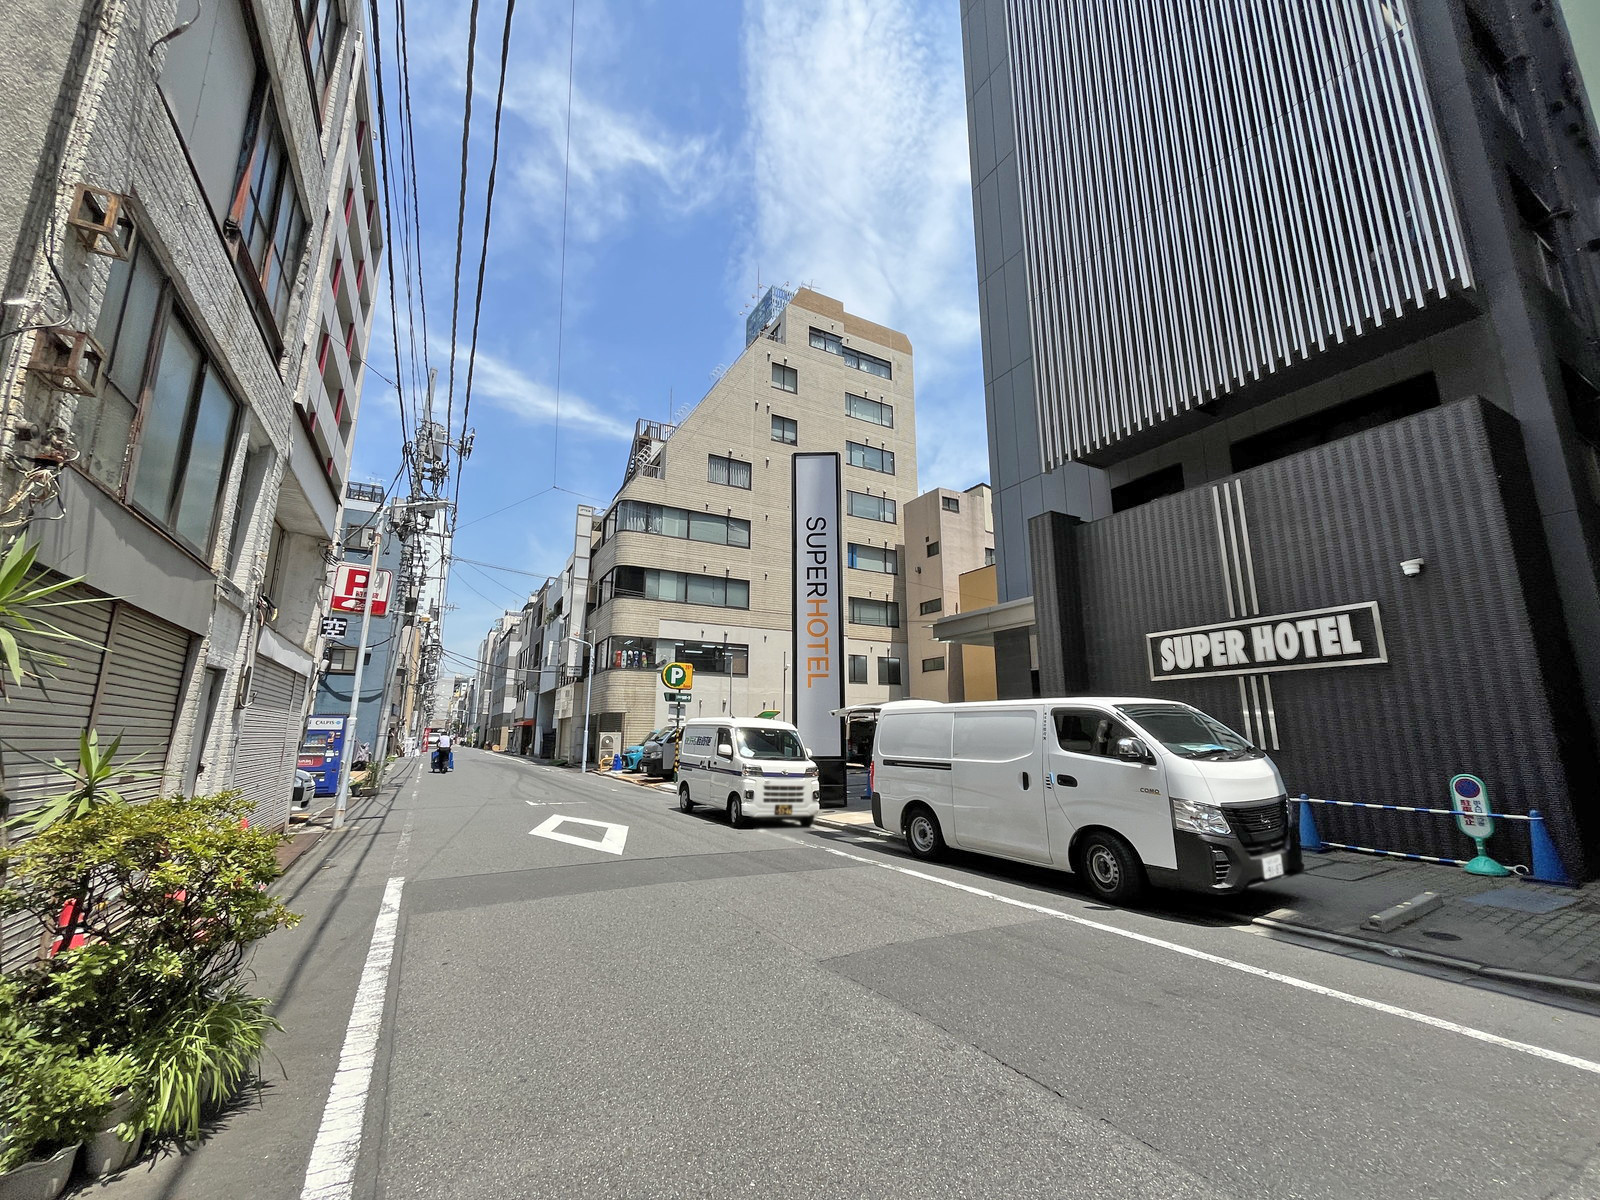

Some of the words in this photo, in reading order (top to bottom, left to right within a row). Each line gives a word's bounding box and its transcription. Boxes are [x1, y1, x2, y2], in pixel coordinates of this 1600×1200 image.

[344, 569, 370, 597] P
[321, 618, 347, 638] 空
[1159, 628, 1250, 672] SUPER
[1251, 613, 1363, 662] HOTEL
[670, 667, 684, 684] P
